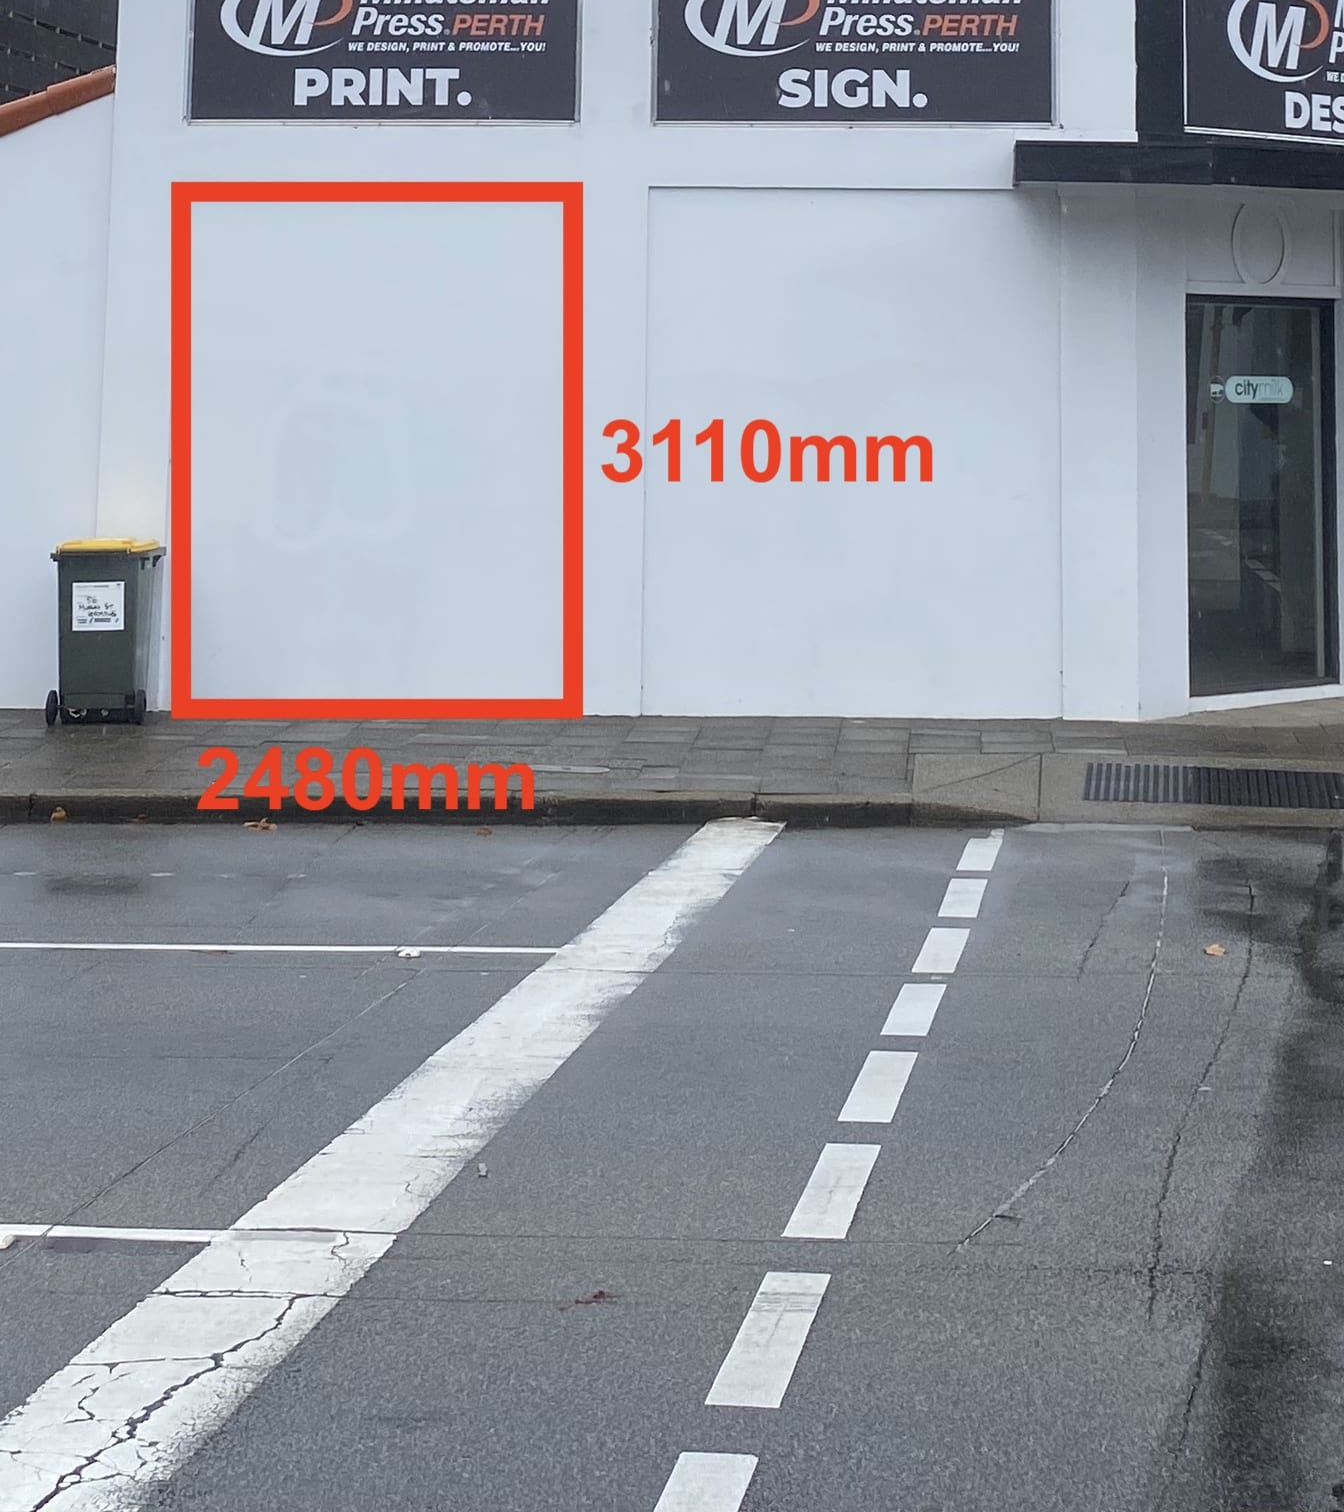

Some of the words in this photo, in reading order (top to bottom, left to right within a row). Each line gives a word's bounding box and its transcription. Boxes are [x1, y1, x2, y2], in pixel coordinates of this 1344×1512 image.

[348, 42, 365, 52] WE
[366, 42, 410, 53] DESIGN,
[412, 42, 446, 52] PRINT
[447, 42, 456, 52] &
[816, 42, 833, 52] WE
[835, 42, 879, 53] DESIGN,
[882, 42, 916, 53] PRINT
[918, 42, 926, 52] &
[1326, 71, 1339, 82] WE
[293, 68, 472, 106] PRINT.
[778, 68, 928, 108] SIGN.
